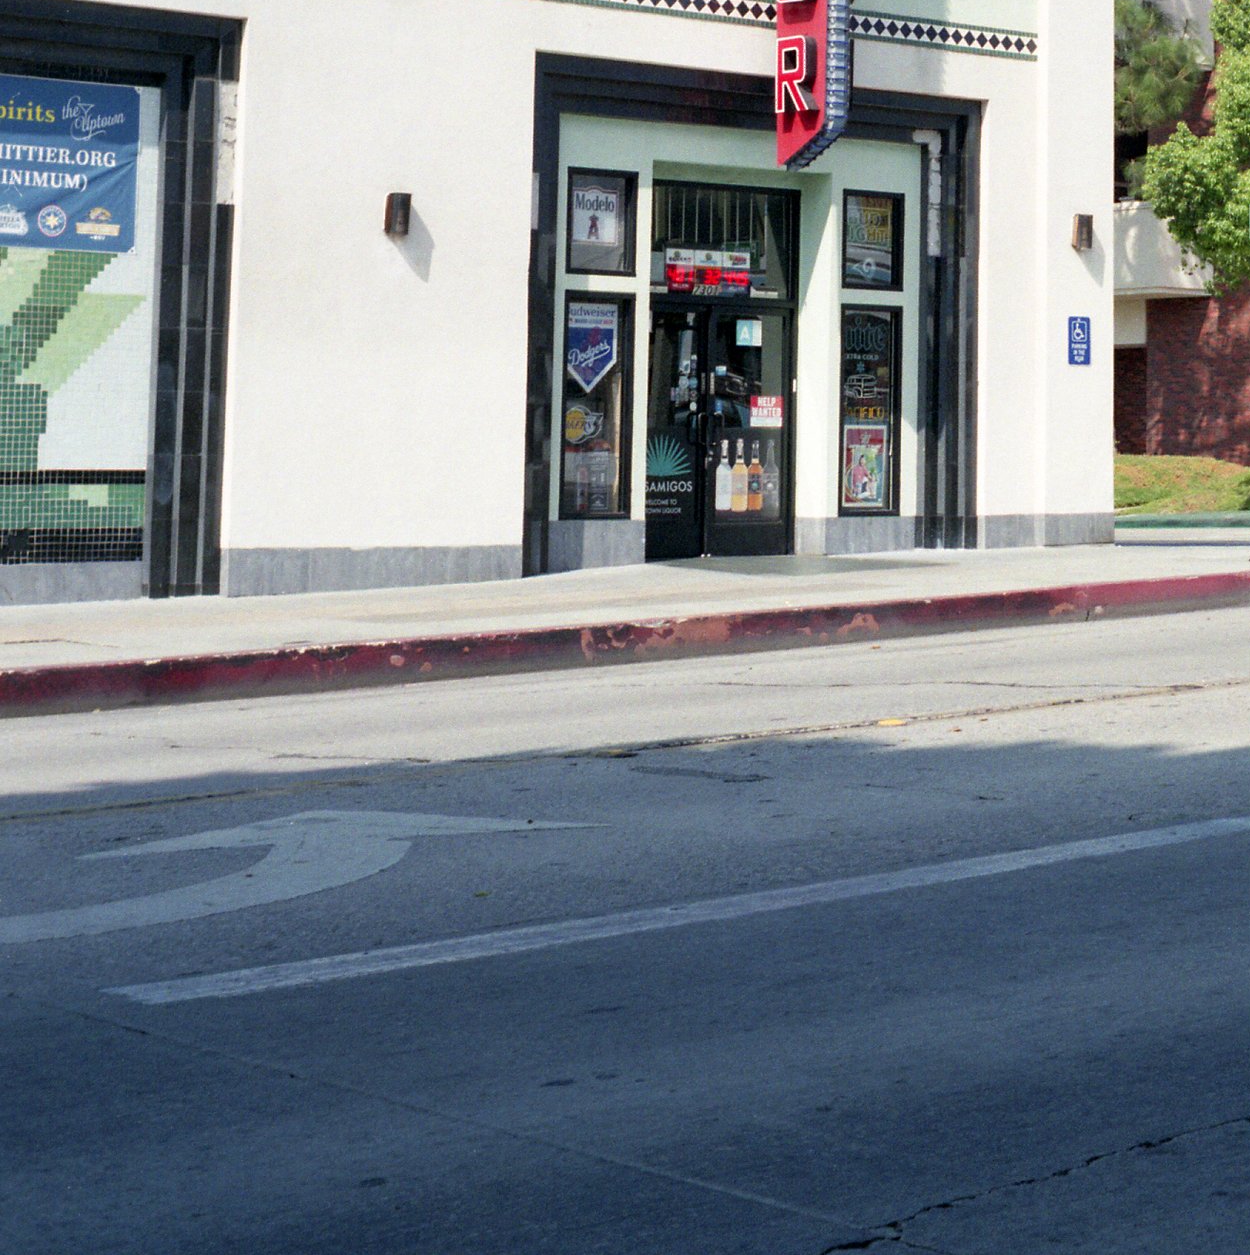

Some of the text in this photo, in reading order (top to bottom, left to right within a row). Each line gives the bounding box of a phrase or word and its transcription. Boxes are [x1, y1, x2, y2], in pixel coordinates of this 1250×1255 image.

[62, 95, 80, 120] the
[0, 143, 116, 168] ITTIER.ORG
[574, 192, 615, 213] Modelo
[740, 326, 751, 340] A
[568, 340, 610, 367] Dodgers
[751, 407, 782, 417] WANTED
[757, 397, 776, 406] HELP
